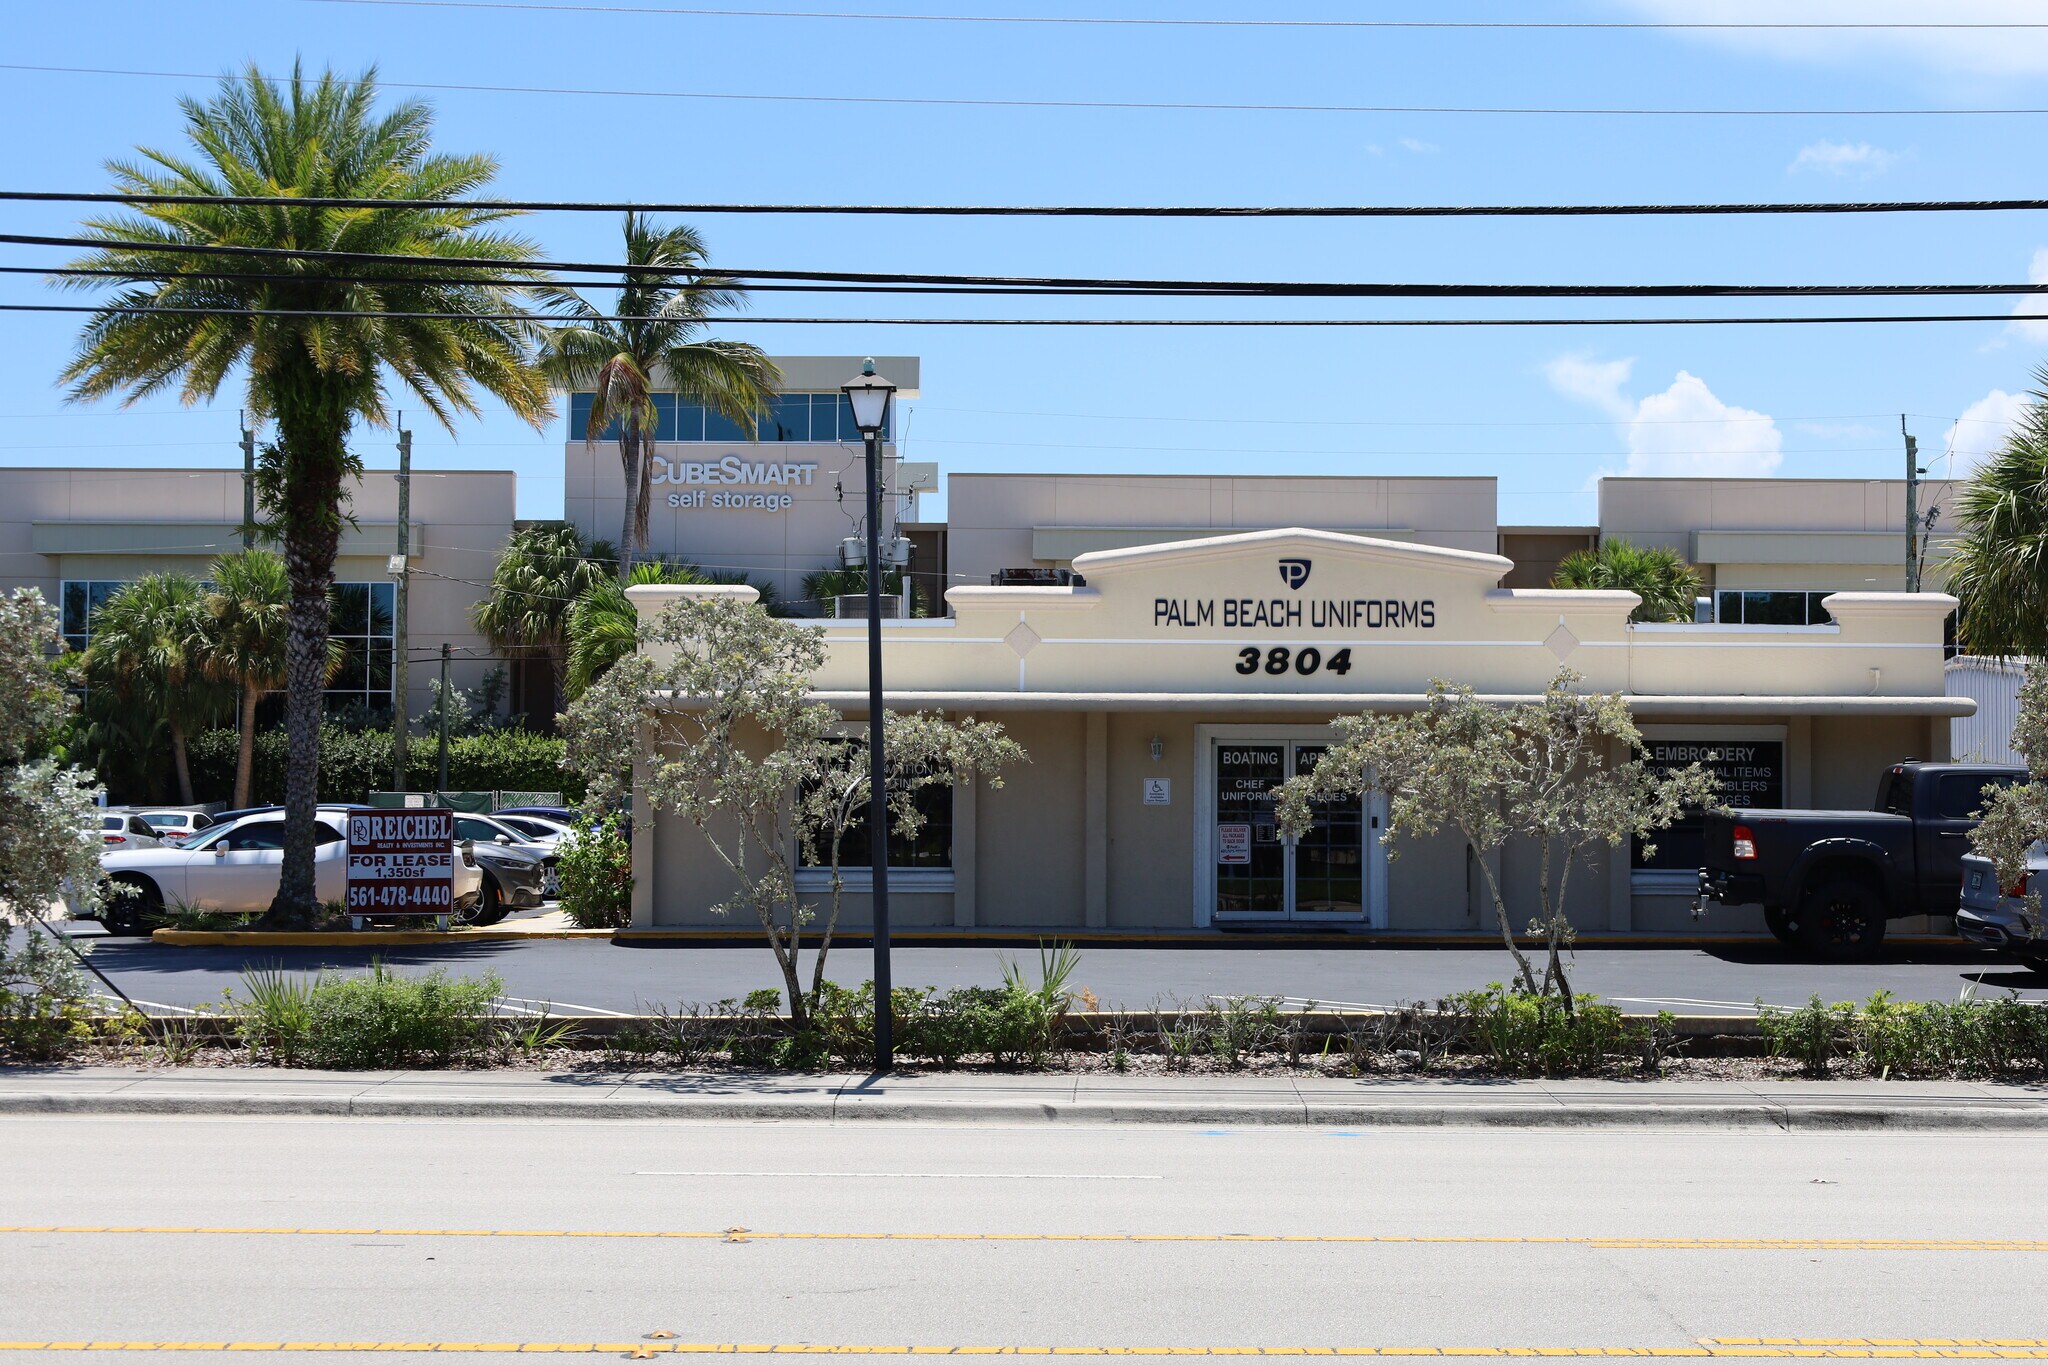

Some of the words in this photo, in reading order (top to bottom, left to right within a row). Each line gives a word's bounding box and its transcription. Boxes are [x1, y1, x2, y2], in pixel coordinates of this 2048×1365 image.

[668, 490, 706, 508] self
[711, 492, 793, 513] storage
[1154, 599, 1214, 627] PALM
[1223, 599, 1302, 628] BEACH
[1311, 600, 1436, 628] UNIFORMS
[1235, 647, 1352, 676] 3804
[1223, 752, 1278, 765] BOATING
[1733, 767, 1772, 778] ITEMS
[1235, 779, 1265, 789] CHEF
[1221, 791, 1280, 801] UNIFORMS
[371, 816, 451, 840] REICHEL
[349, 855, 386, 867] FOR
[392, 855, 451, 867] LEASE
[375, 868, 425, 879] 1,350sf
[350, 885, 450, 907] 561-478-4440
